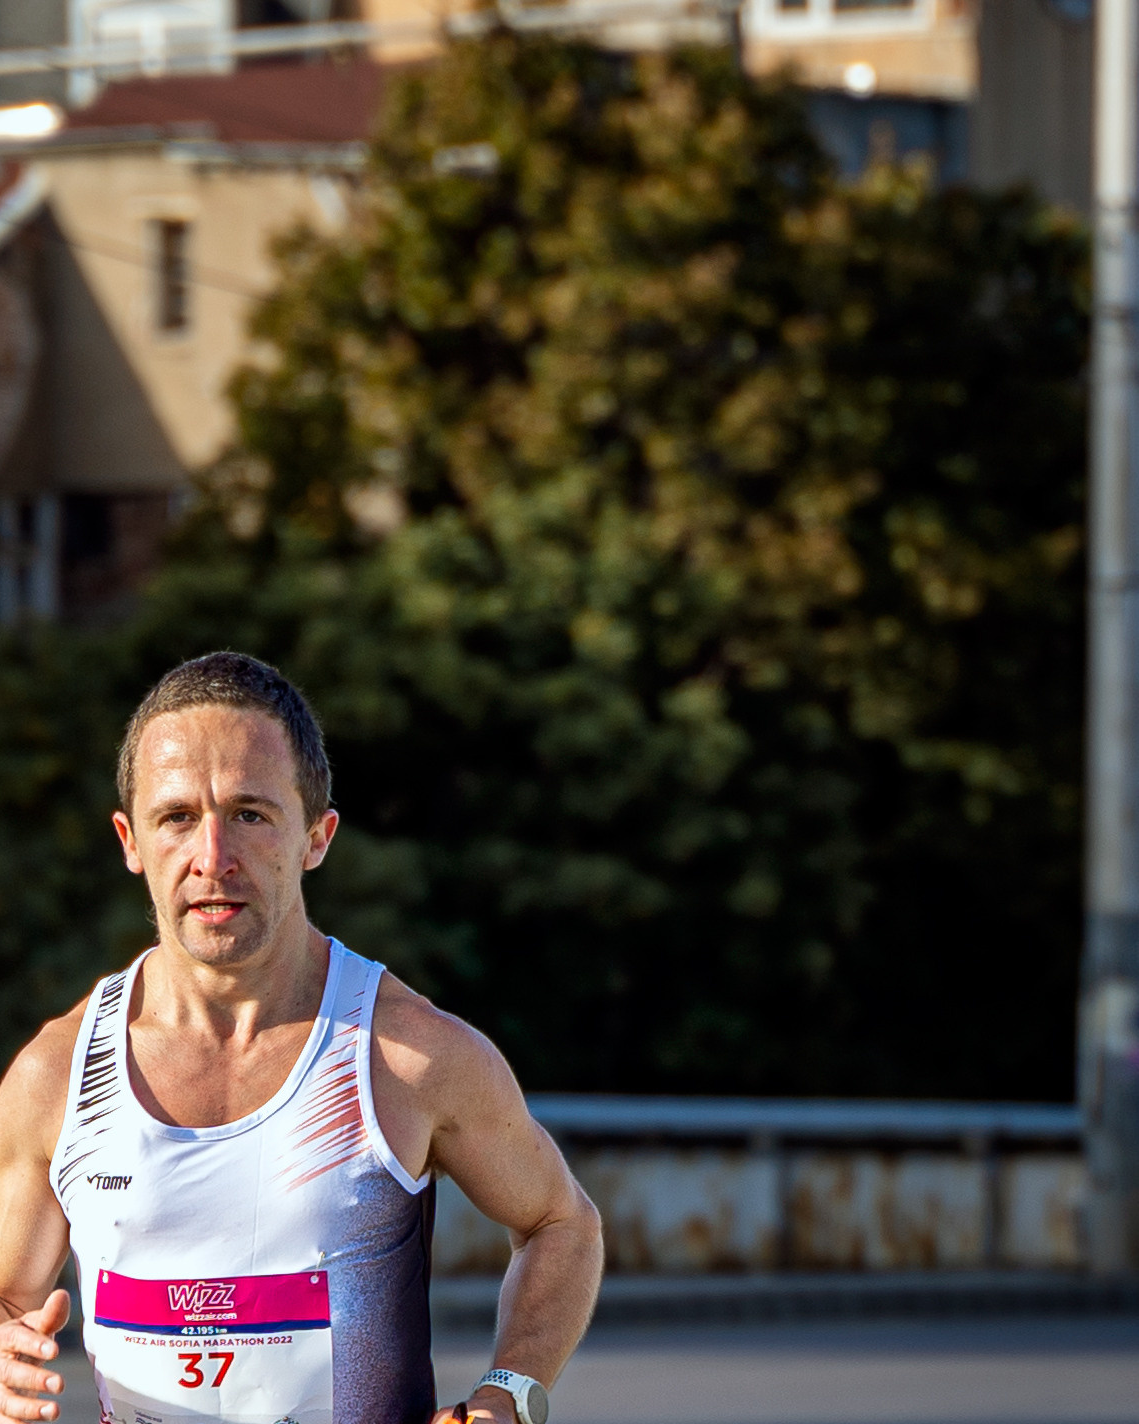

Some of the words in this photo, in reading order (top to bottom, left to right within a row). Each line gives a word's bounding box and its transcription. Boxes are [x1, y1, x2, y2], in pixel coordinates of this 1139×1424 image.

[96, 1175, 132, 1190] TOMY
[184, 1313, 237, 1321] wizzair.com
[181, 1326, 214, 1335] 42.195
[124, 1335, 147, 1345] WIZZ
[150, 1337, 166, 1347] AIR
[169, 1338, 200, 1347] SOFIA
[204, 1337, 264, 1347] MARATHON
[267, 1335, 293, 1344] 2022
[178, 1352, 234, 1388] 37
